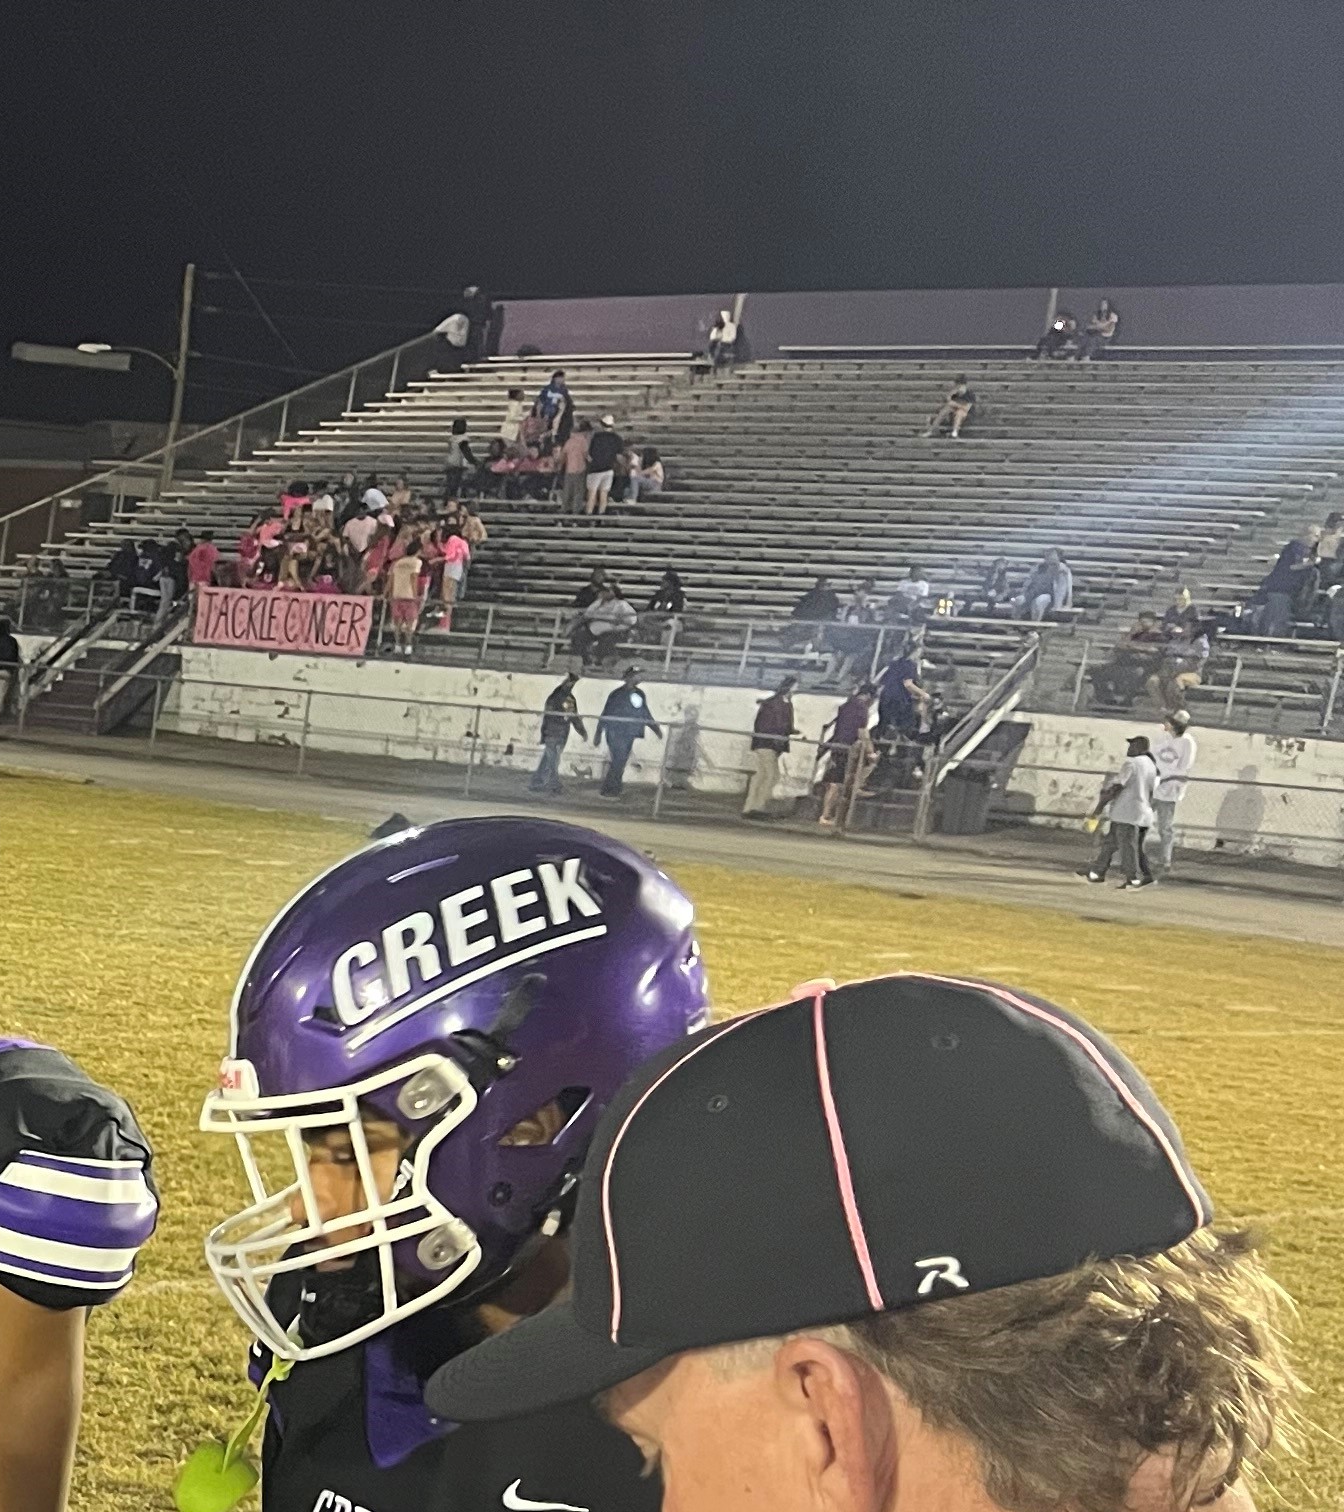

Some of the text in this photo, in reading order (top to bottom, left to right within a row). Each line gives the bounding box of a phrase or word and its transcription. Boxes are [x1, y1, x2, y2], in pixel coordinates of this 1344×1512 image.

[204, 591, 367, 647] TACKLE CNCER
[331, 857, 602, 1027] CREEK
